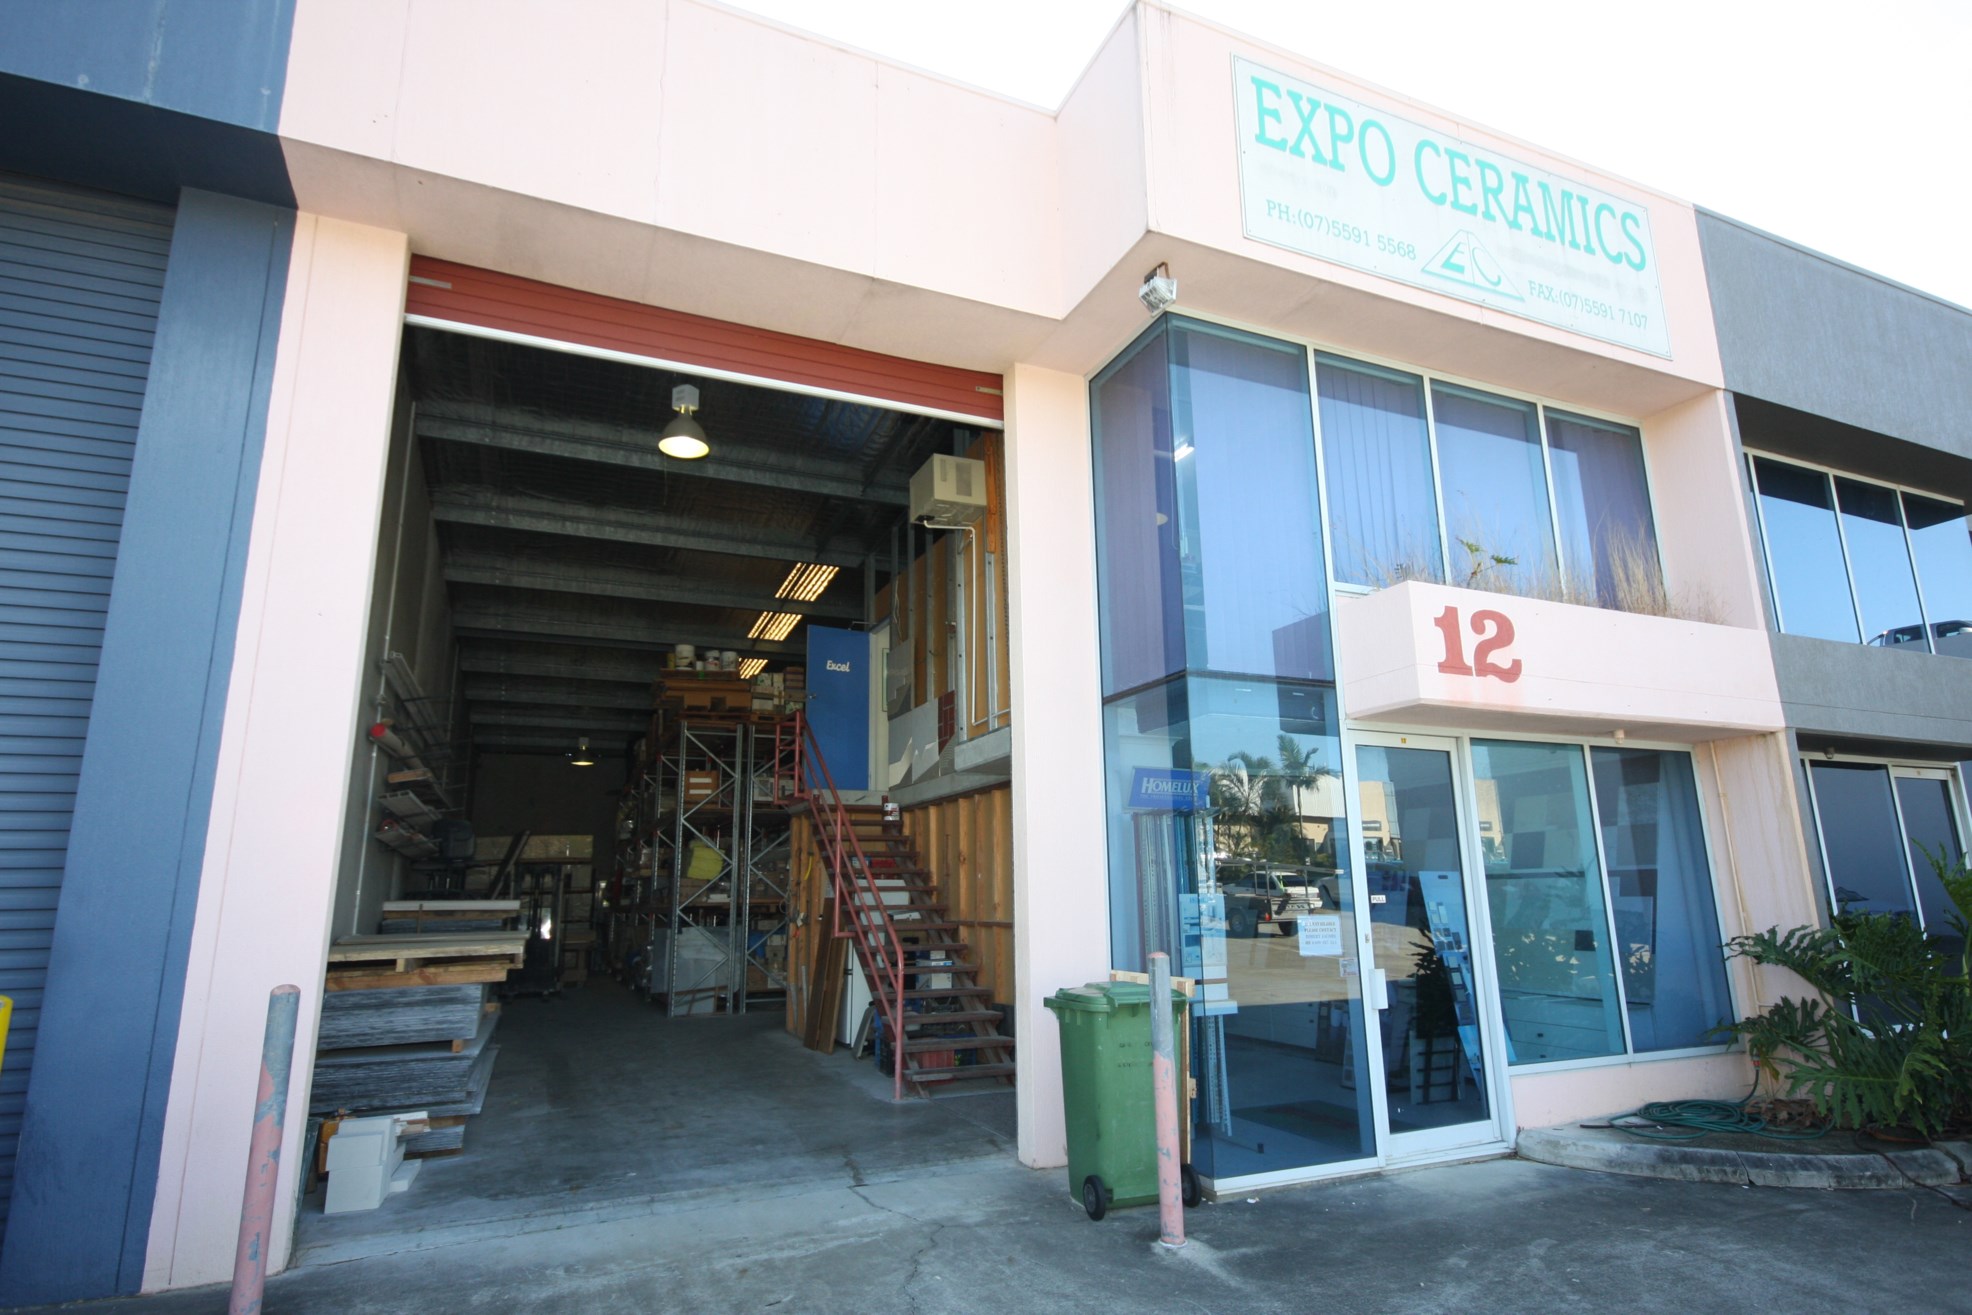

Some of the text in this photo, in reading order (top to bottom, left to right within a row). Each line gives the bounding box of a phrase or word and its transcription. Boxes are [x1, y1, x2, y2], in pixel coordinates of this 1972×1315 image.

[1251, 75, 1646, 271] EXPO CERAMICS
[1377, 234, 1417, 261] 5568
[1619, 309, 1648, 330] 7107
[1433, 605, 1522, 683] 12
[826, 660, 850, 672] Excel
